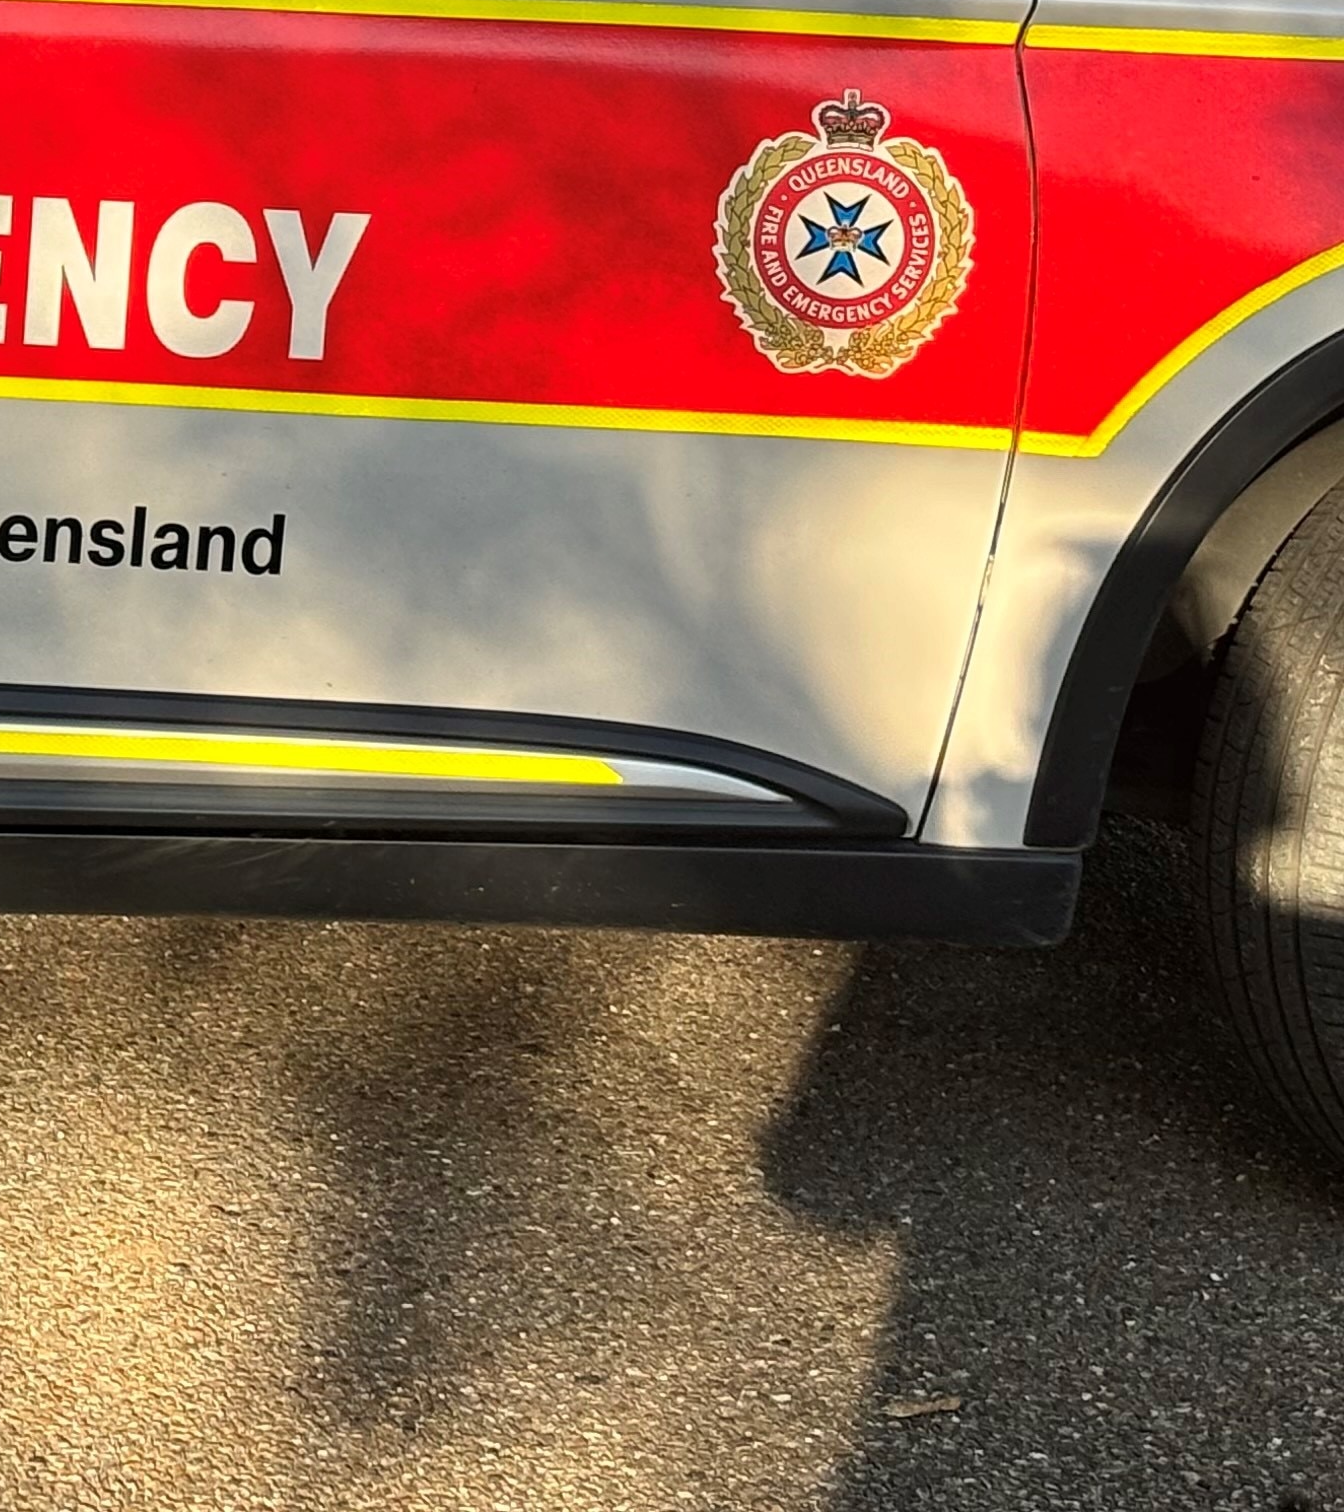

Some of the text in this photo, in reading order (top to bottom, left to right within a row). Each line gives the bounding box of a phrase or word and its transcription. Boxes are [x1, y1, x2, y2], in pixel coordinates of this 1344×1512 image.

[789, 158, 910, 198] QUEENSLAND
[760, 204, 930, 323] FIRE AND EMERGENCY SERVICES
